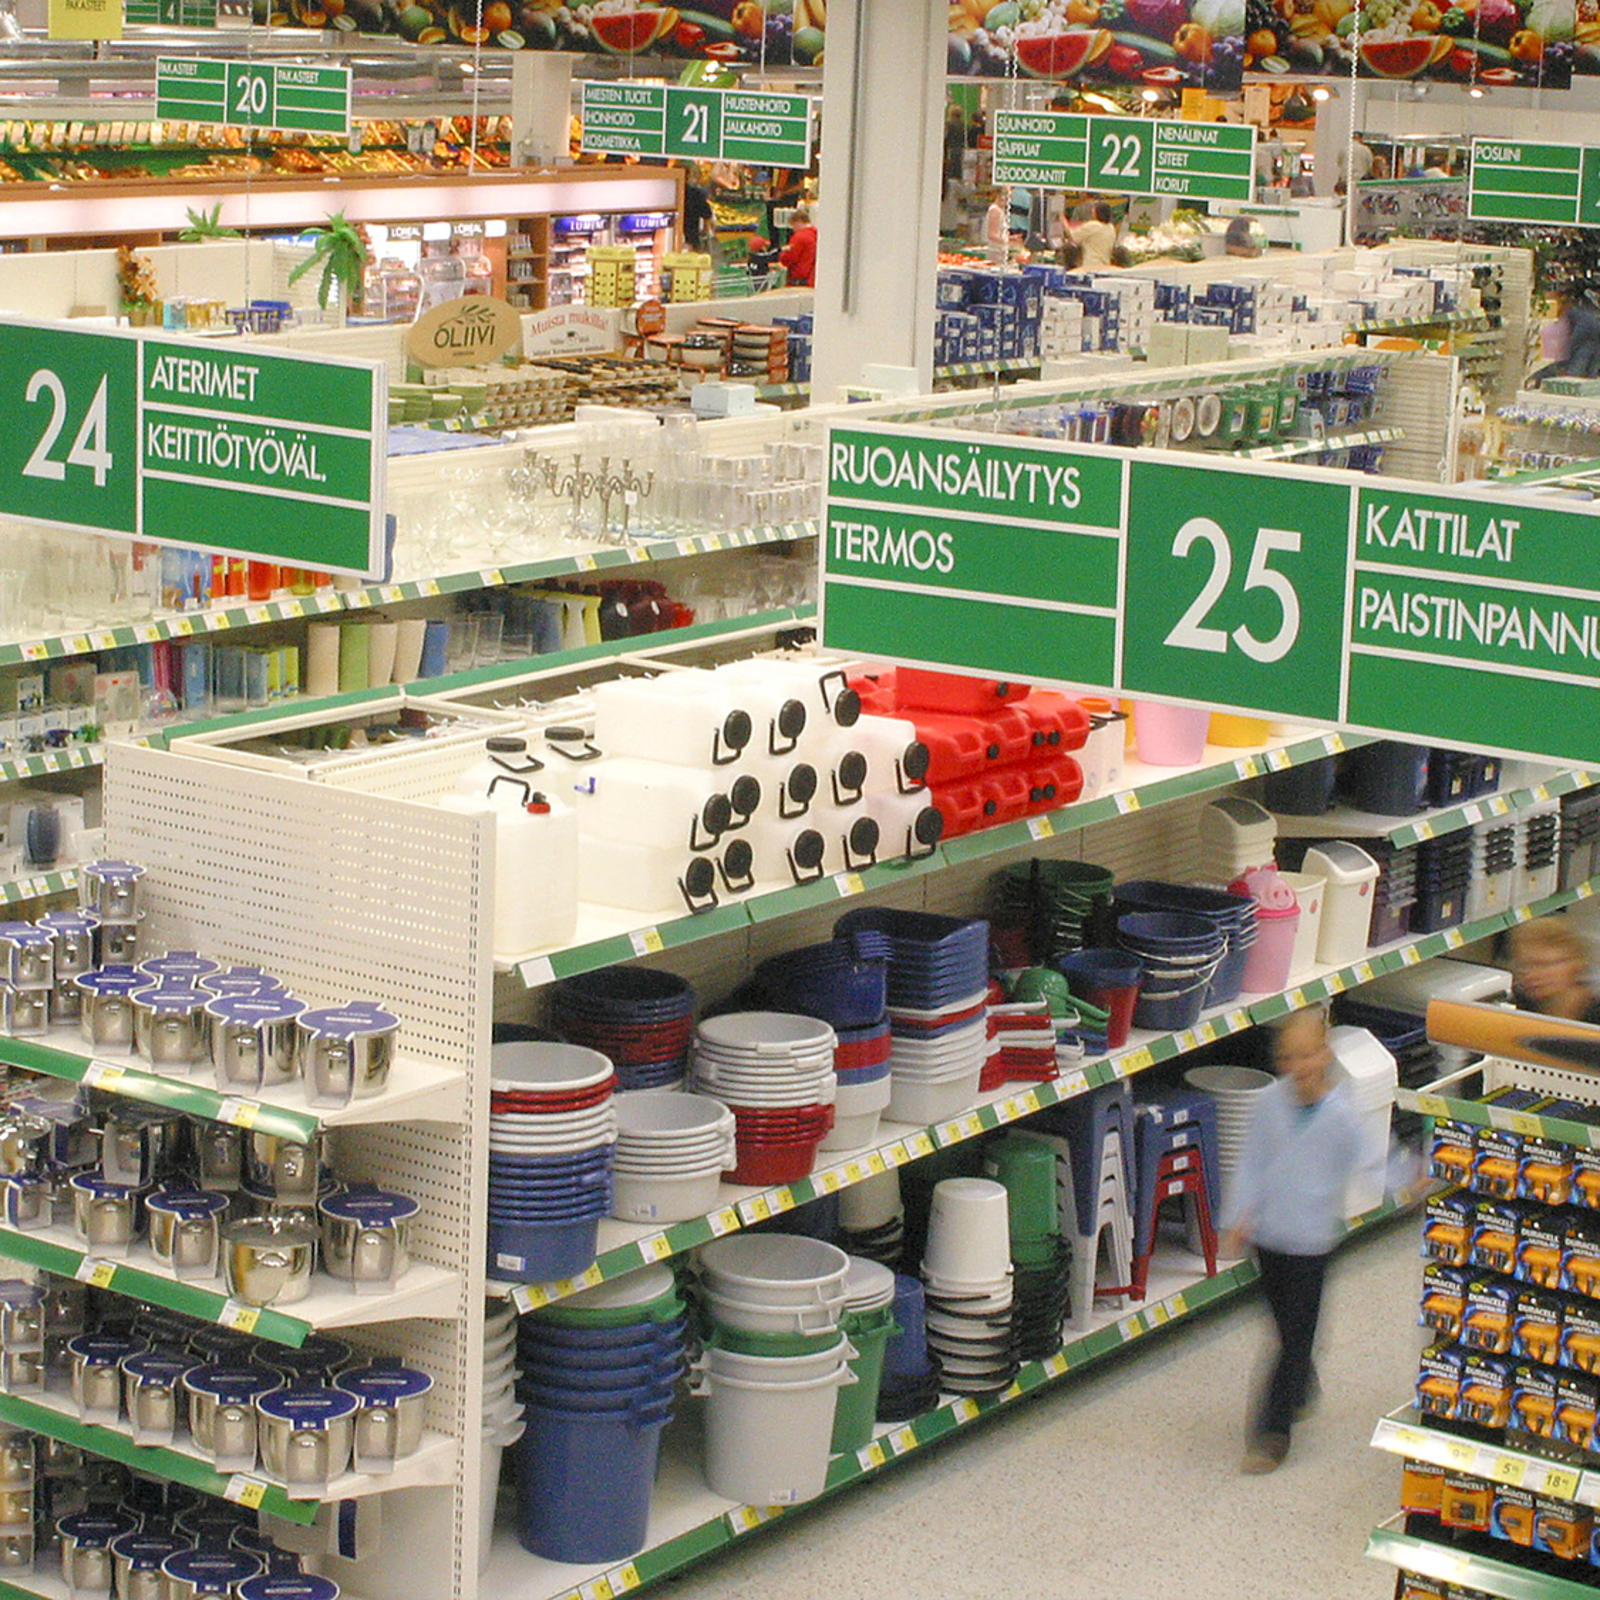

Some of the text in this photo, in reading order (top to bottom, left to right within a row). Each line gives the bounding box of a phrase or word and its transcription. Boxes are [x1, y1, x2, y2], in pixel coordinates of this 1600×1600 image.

[158, 62, 198, 75] PAKASTEET
[277, 69, 319, 84] PAKASTEET
[236, 75, 267, 114] 20
[585, 88, 622, 101] MIESTEN
[725, 96, 791, 114] HIUSTENHOITO
[681, 103, 709, 144] 21
[725, 119, 782, 136] JALKAHOITO
[1158, 124, 1219, 144] NENÄLIINAT
[584, 134, 641, 150] KOSMETIIKKA
[1100, 133, 1141, 177] 22
[1158, 151, 1190, 166] SITEET
[1475, 145, 1521, 162] POSLIINI
[996, 166, 1066, 183] DEODORANTIT
[1156, 176, 1191, 193] KORUT
[433, 324, 496, 349] OLIIVI
[150, 356, 260, 402] ATERIMET
[22, 369, 113, 487] 24
[147, 422, 327, 482] KEITTIÖTYÖVÄL.
[831, 446, 1082, 509] RUOANSÄILYTYS
[1365, 503, 1521, 562] KATTILAT
[830, 520, 955, 573] TERMOS
[1163, 517, 1301, 664] 25
